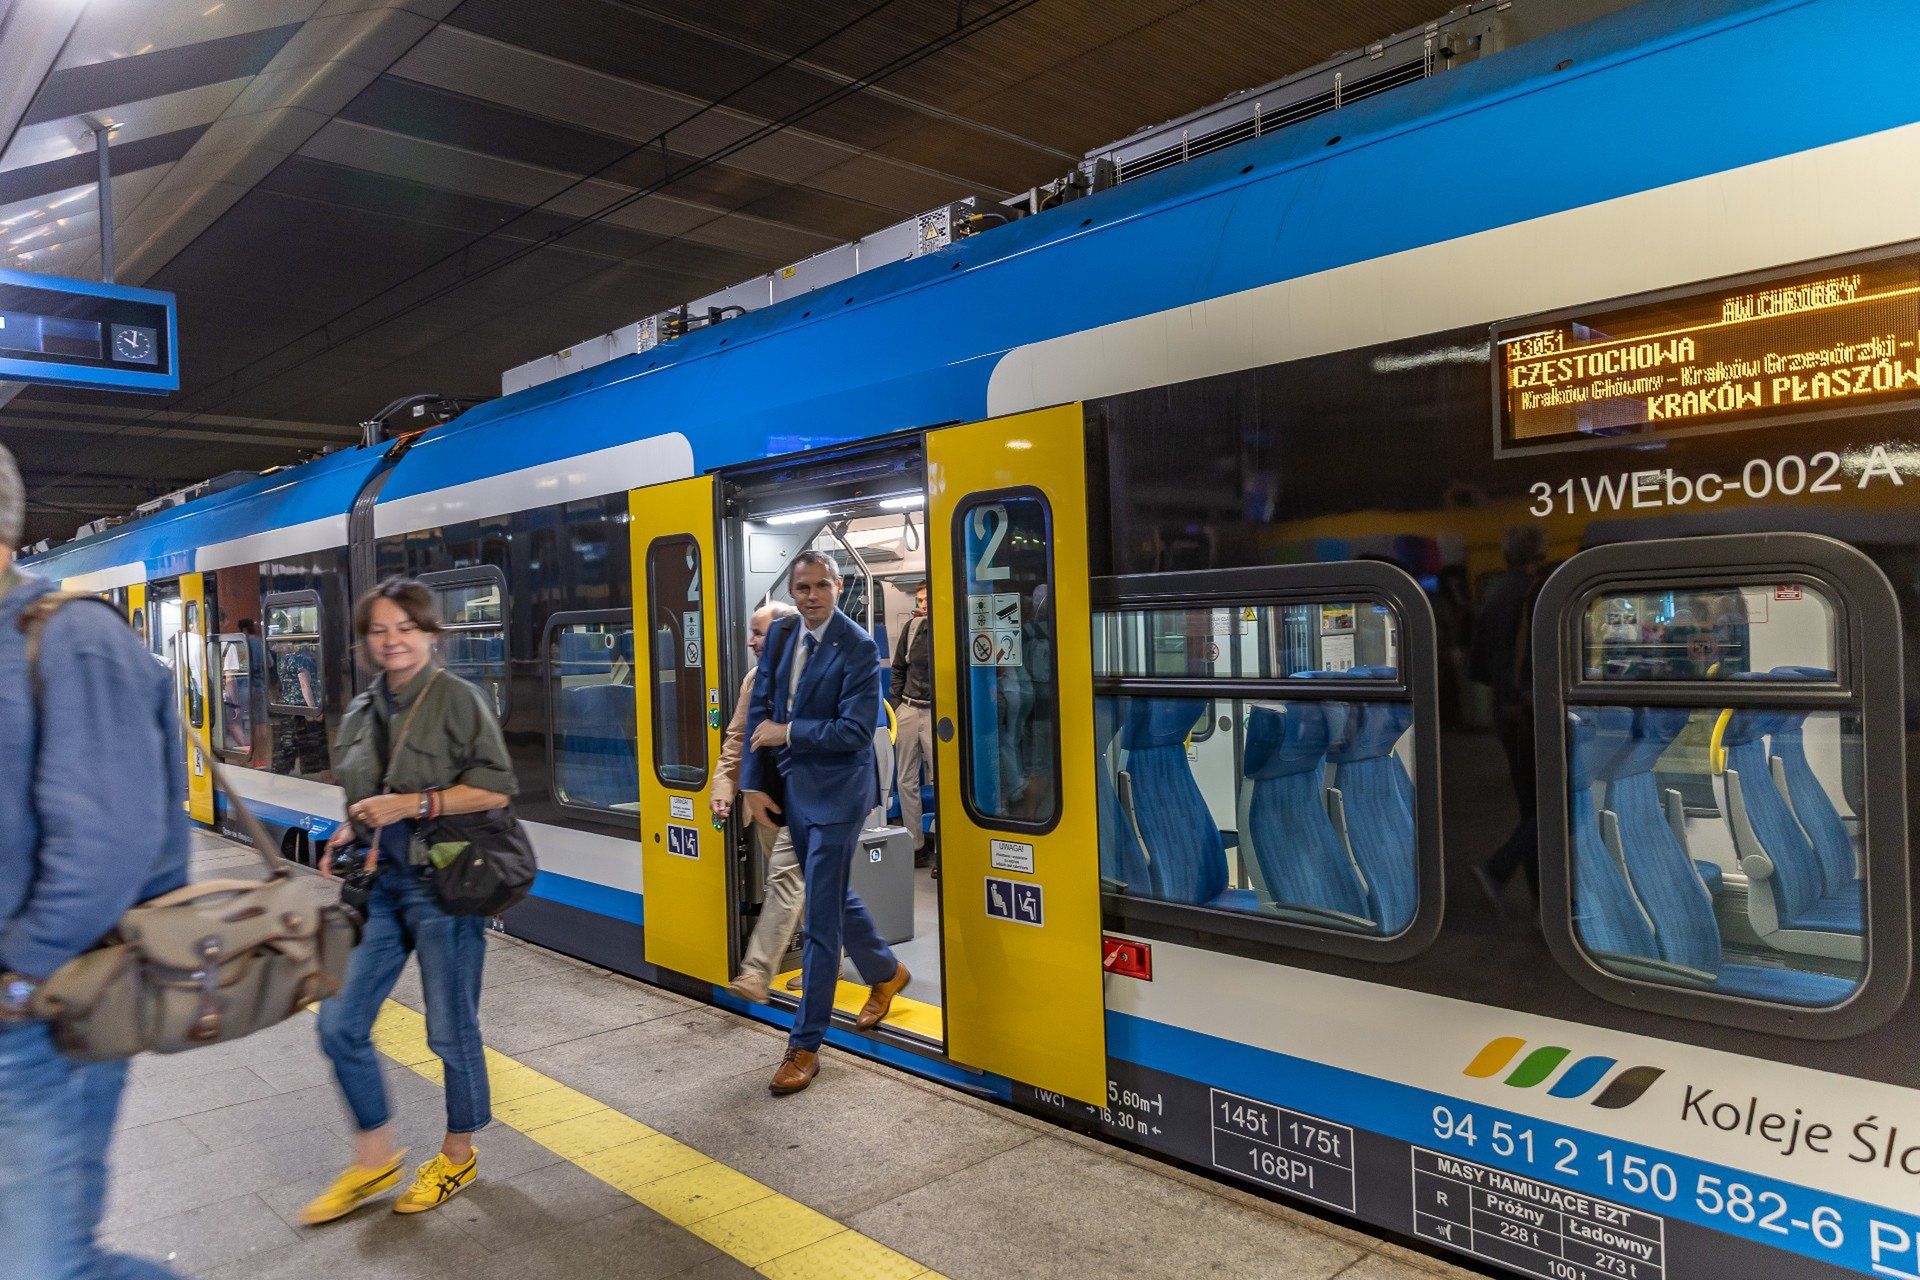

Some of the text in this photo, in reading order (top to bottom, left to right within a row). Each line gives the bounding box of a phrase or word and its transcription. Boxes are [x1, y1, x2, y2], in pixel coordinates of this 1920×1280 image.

[1514, 336, 1695, 388] CZĘSTOCHOWA
[1522, 385, 1589, 410] Kraków
[1592, 375, 1664, 400] Główny
[1681, 359, 1760, 387] Kraków
[1764, 334, 1895, 375] Grzegórzki
[1647, 357, 1920, 420] KRAKÓW PŁASZÓW
[1529, 445, 1904, 518] 31WEbc-002 A
[974, 503, 1011, 581] 2
[1221, 1101, 1341, 1158] 145t 175t
[1681, 1084, 1833, 1156] Koleje
[1432, 1105, 1477, 1147] 94
[1492, 1121, 1533, 1163] 51
[1554, 1138, 1579, 1176] 2
[1597, 1149, 1678, 1202] 150
[1696, 1174, 1844, 1250] 582-6
[1436, 1190, 1449, 1207] R
[1437, 1157, 1631, 1227] MASY HAMUJĄCE EZT
[1487, 1193, 1545, 1226] Próżny
[1500, 1221, 1539, 1247] 228 t
[1569, 1219, 1653, 1259] Ładowny
[1595, 1252, 1638, 1279] 273 t
[1547, 1260, 1577, 1280] 100
